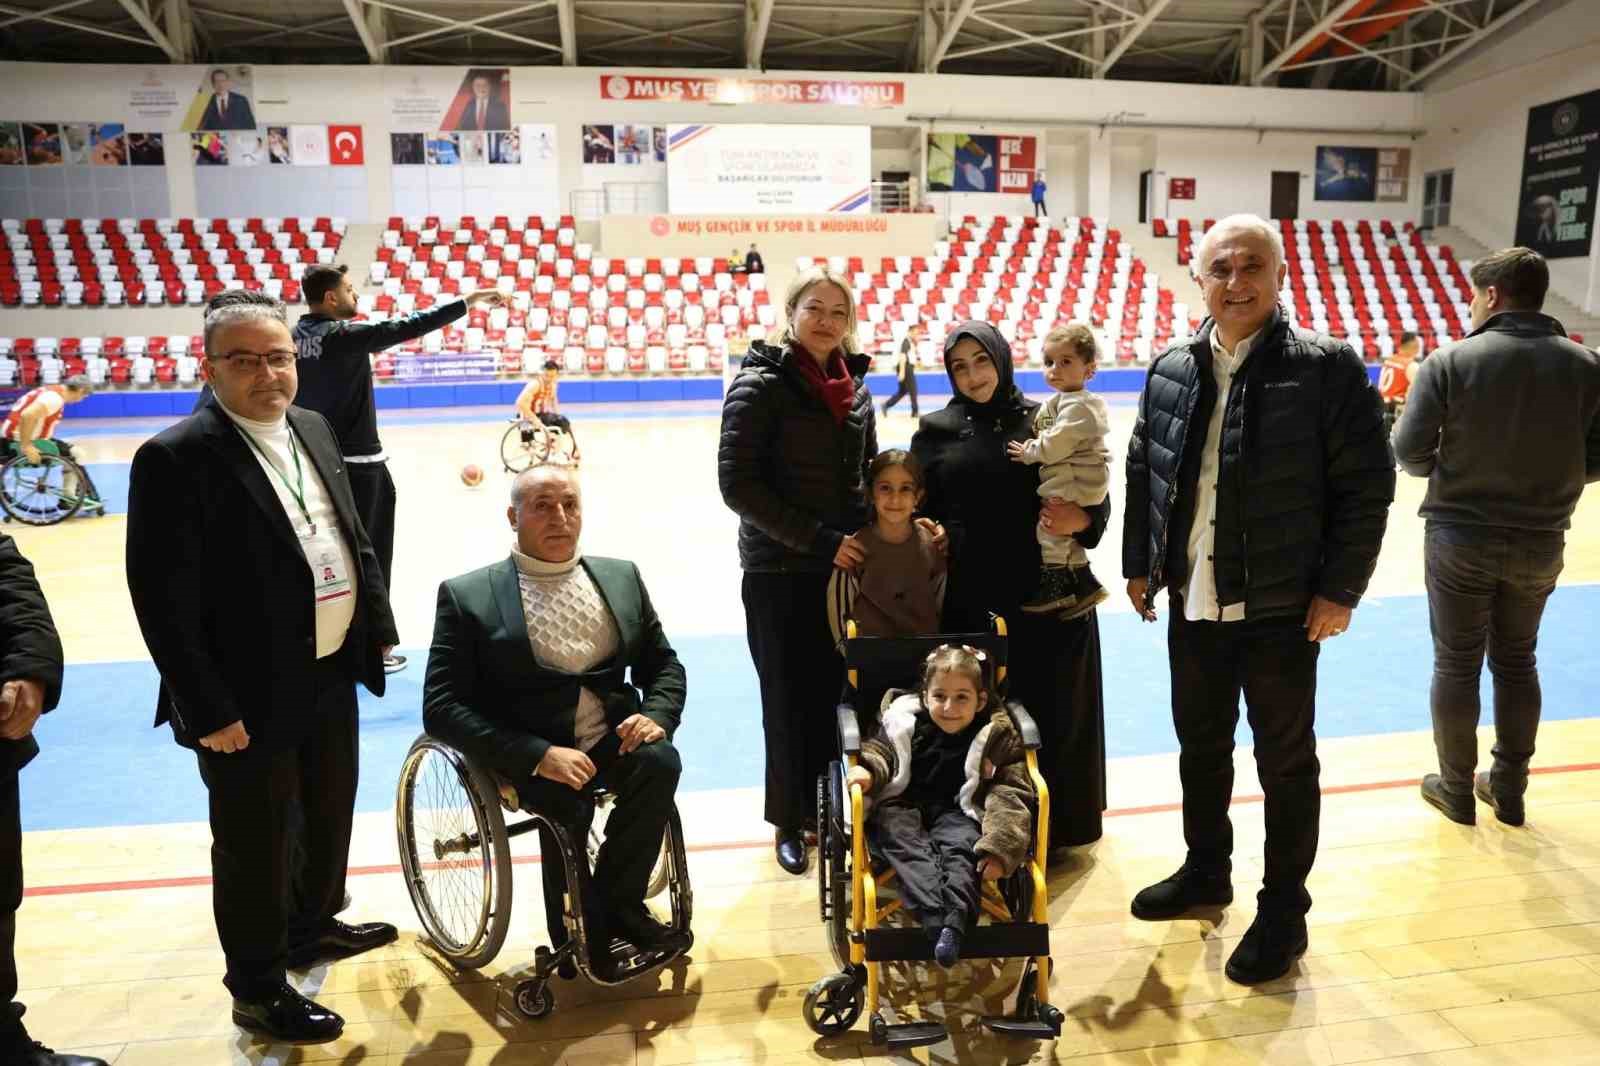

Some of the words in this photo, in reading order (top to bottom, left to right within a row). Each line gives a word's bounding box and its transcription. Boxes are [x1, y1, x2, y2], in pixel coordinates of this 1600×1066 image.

[806, 84, 895, 101] SALONU
[677, 219, 701, 236] MUŞ
[706, 218, 751, 236] GENÇLİK
[756, 219, 770, 233] VE
[774, 219, 803, 233] SPOR
[820, 217, 888, 233] MÜDÜRLÜĞÜ
[297, 335, 323, 360] UŞ
